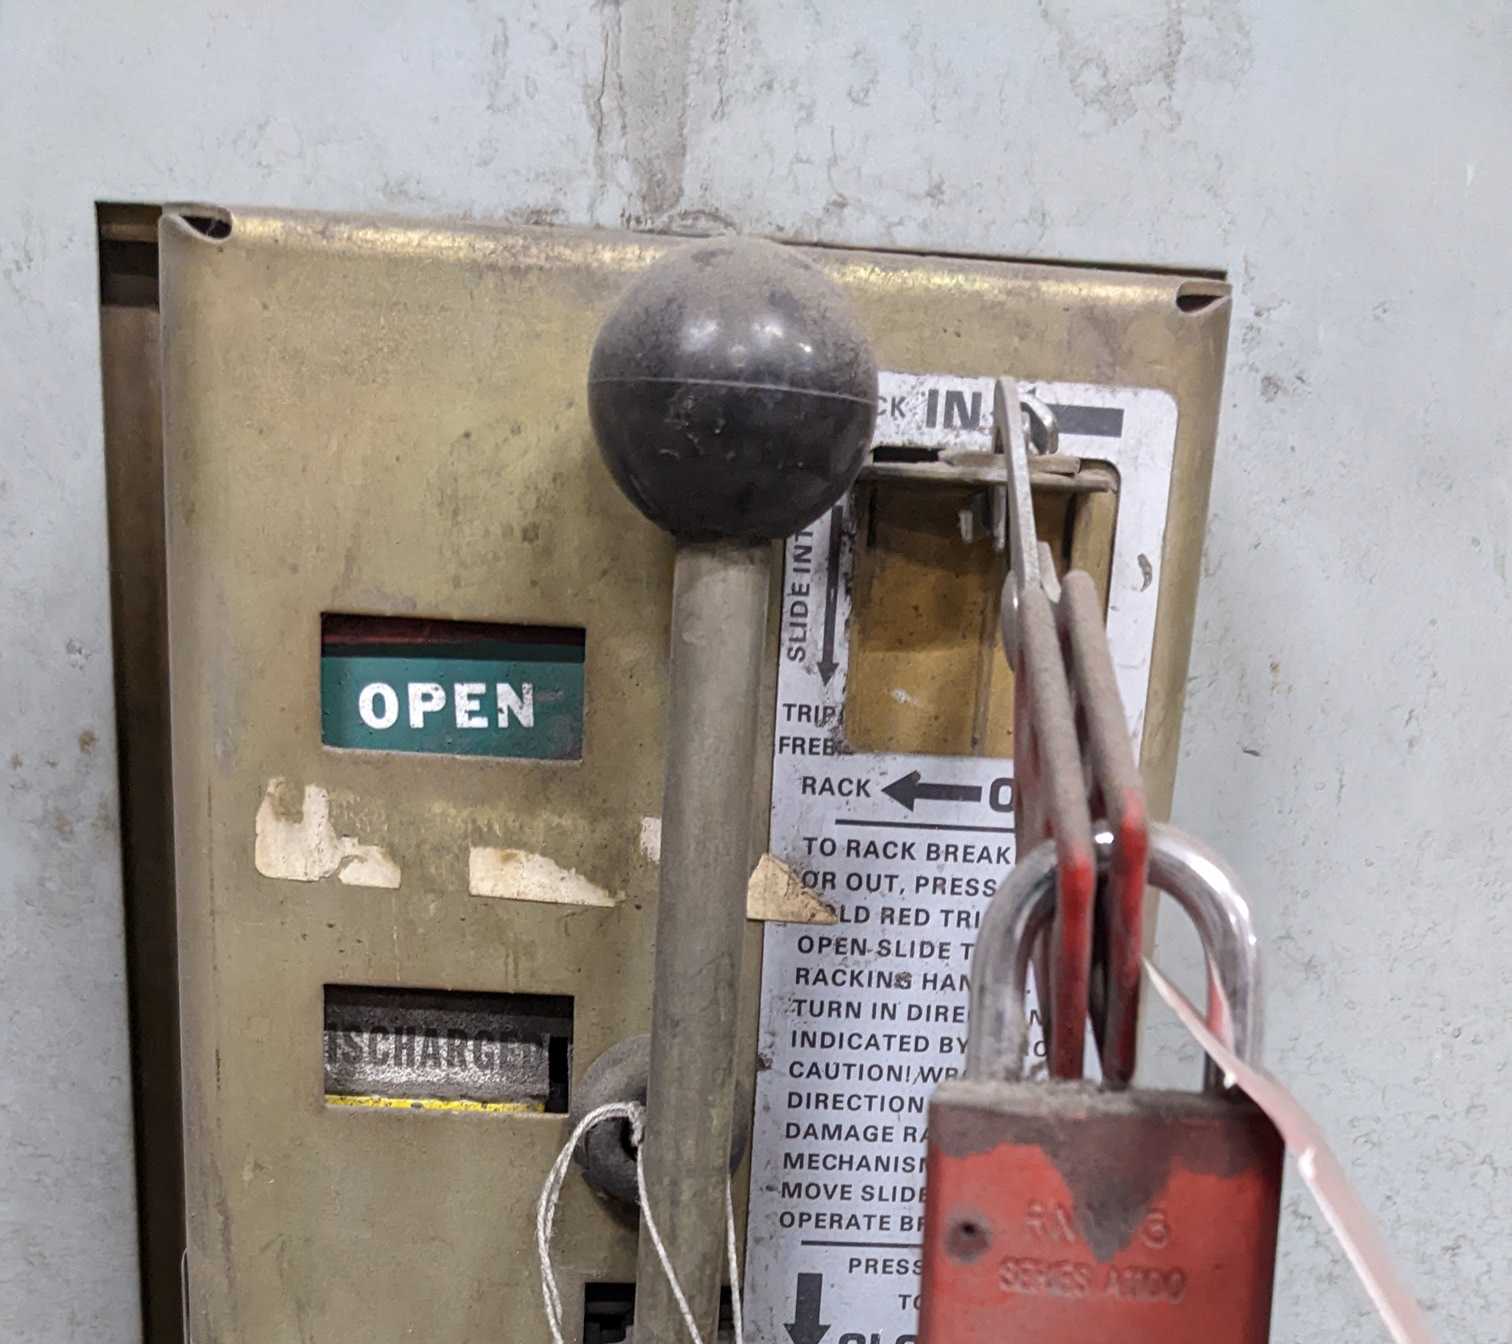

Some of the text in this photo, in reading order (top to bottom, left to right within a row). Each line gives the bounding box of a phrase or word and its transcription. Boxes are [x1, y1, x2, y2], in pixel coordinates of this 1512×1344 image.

[926, 388, 982, 429] IN
[788, 584, 810, 662] SLIDE
[358, 682, 534, 730] OPEN
[801, 776, 872, 799] RACK
[803, 837, 836, 857] TO
[846, 839, 916, 861] RACK
[801, 870, 997, 898] OR OUT, PRESS
[880, 907, 930, 926] RED
[797, 936, 867, 957] OPEN
[877, 939, 950, 960] SLIDE
[795, 968, 912, 989] RACKING
[793, 1000, 862, 1020] TURN
[872, 1002, 897, 1021] IN
[791, 1030, 968, 1054] INDICATED BY
[789, 1061, 911, 1083] CAUTION!
[787, 1092, 924, 1113] DIRECTION
[785, 1122, 894, 1143] DAMAGE
[781, 1182, 852, 1201] MOVE
[779, 1211, 891, 1231] OPERATE
[849, 1258, 922, 1275] PRESS
